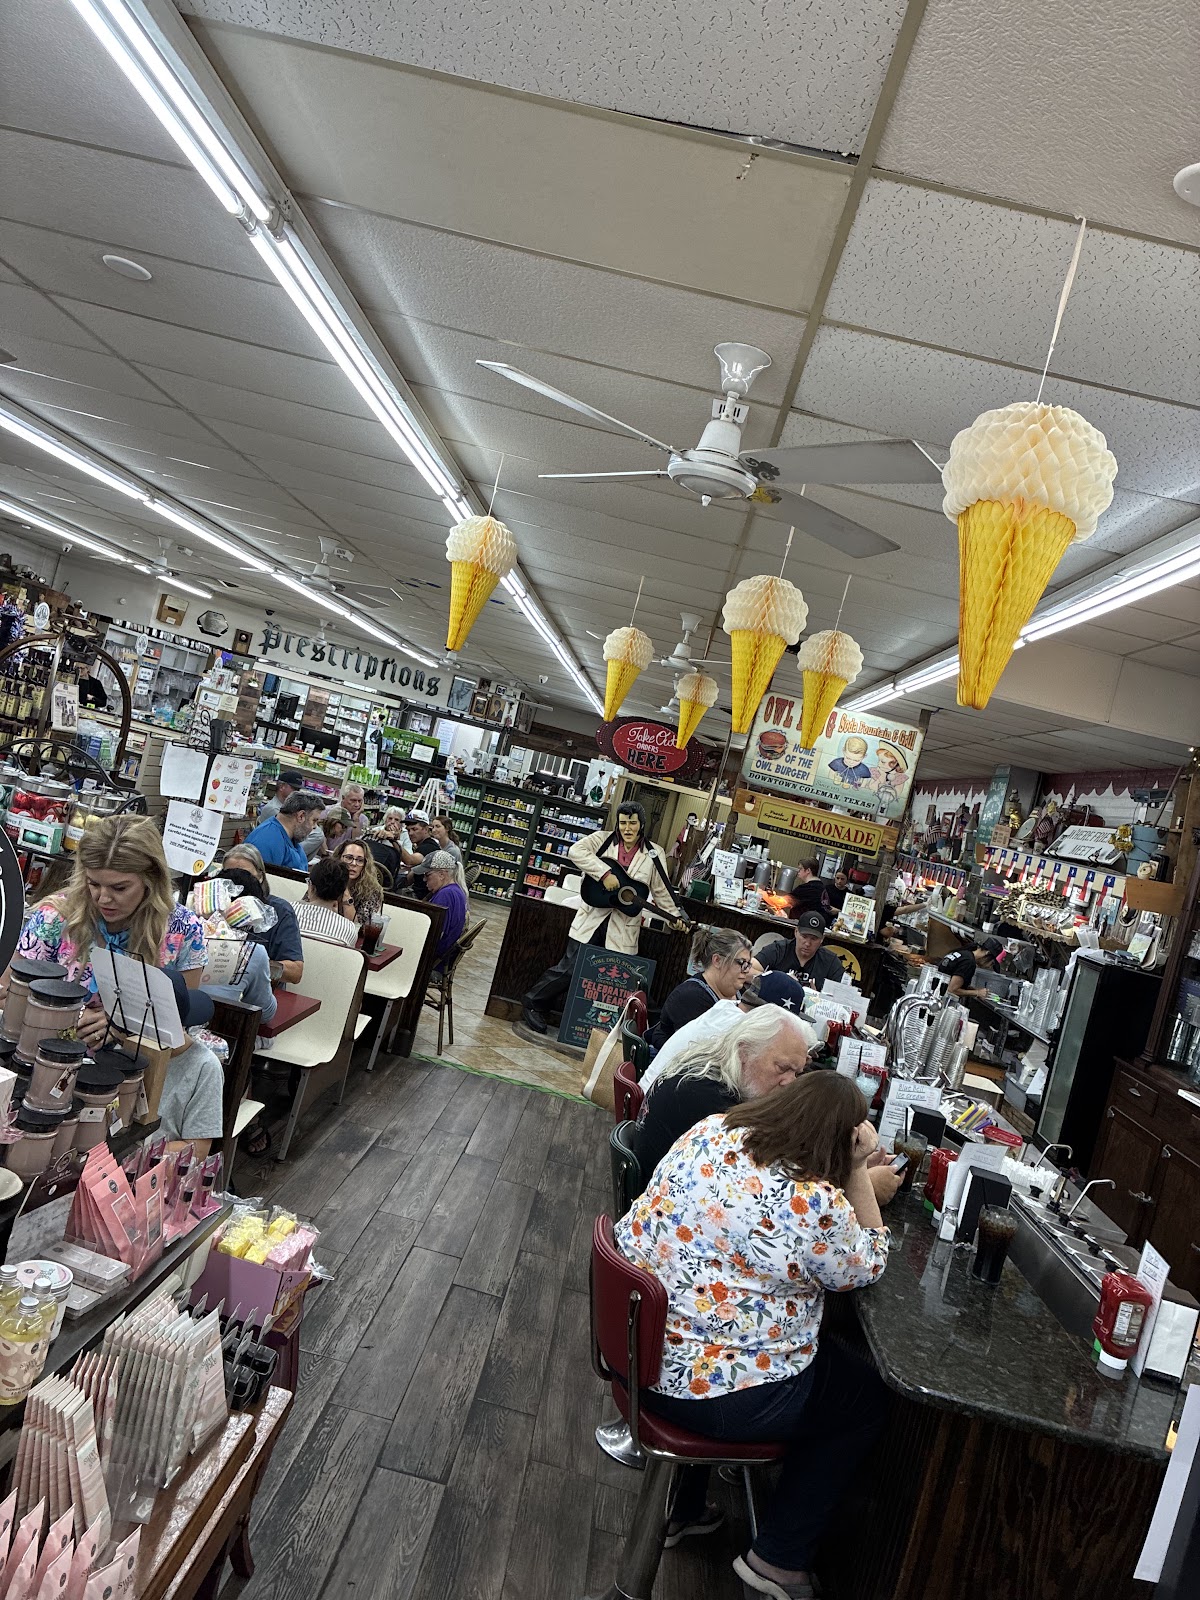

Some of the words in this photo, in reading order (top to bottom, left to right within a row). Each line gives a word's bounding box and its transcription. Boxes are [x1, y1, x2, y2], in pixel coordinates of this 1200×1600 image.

[258, 620, 441, 697] Prescriptions
[763, 695, 795, 728] OWL
[838, 713, 858, 734] Soda
[858, 721, 892, 742] Fountain
[899, 730, 918, 751] Grill
[627, 726, 655, 744] Take
[655, 730, 678, 748] Out
[627, 747, 668, 770] HERE
[636, 743, 660, 754] ORDERS
[792, 743, 816, 757] HOME
[755, 759, 773, 772] OWL
[774, 764, 811, 781] BURGER!
[785, 753, 797, 764] OF
[799, 757, 814, 769] THE
[748, 772, 798, 791] DOWNTOWN
[799, 785, 841, 802] COLEMAN,
[844, 797, 876, 809] TEXAS!
[788, 813, 876, 847] LEMONADE
[581, 978, 632, 999] CELEBRATIN
[584, 989, 599, 1001] 100
